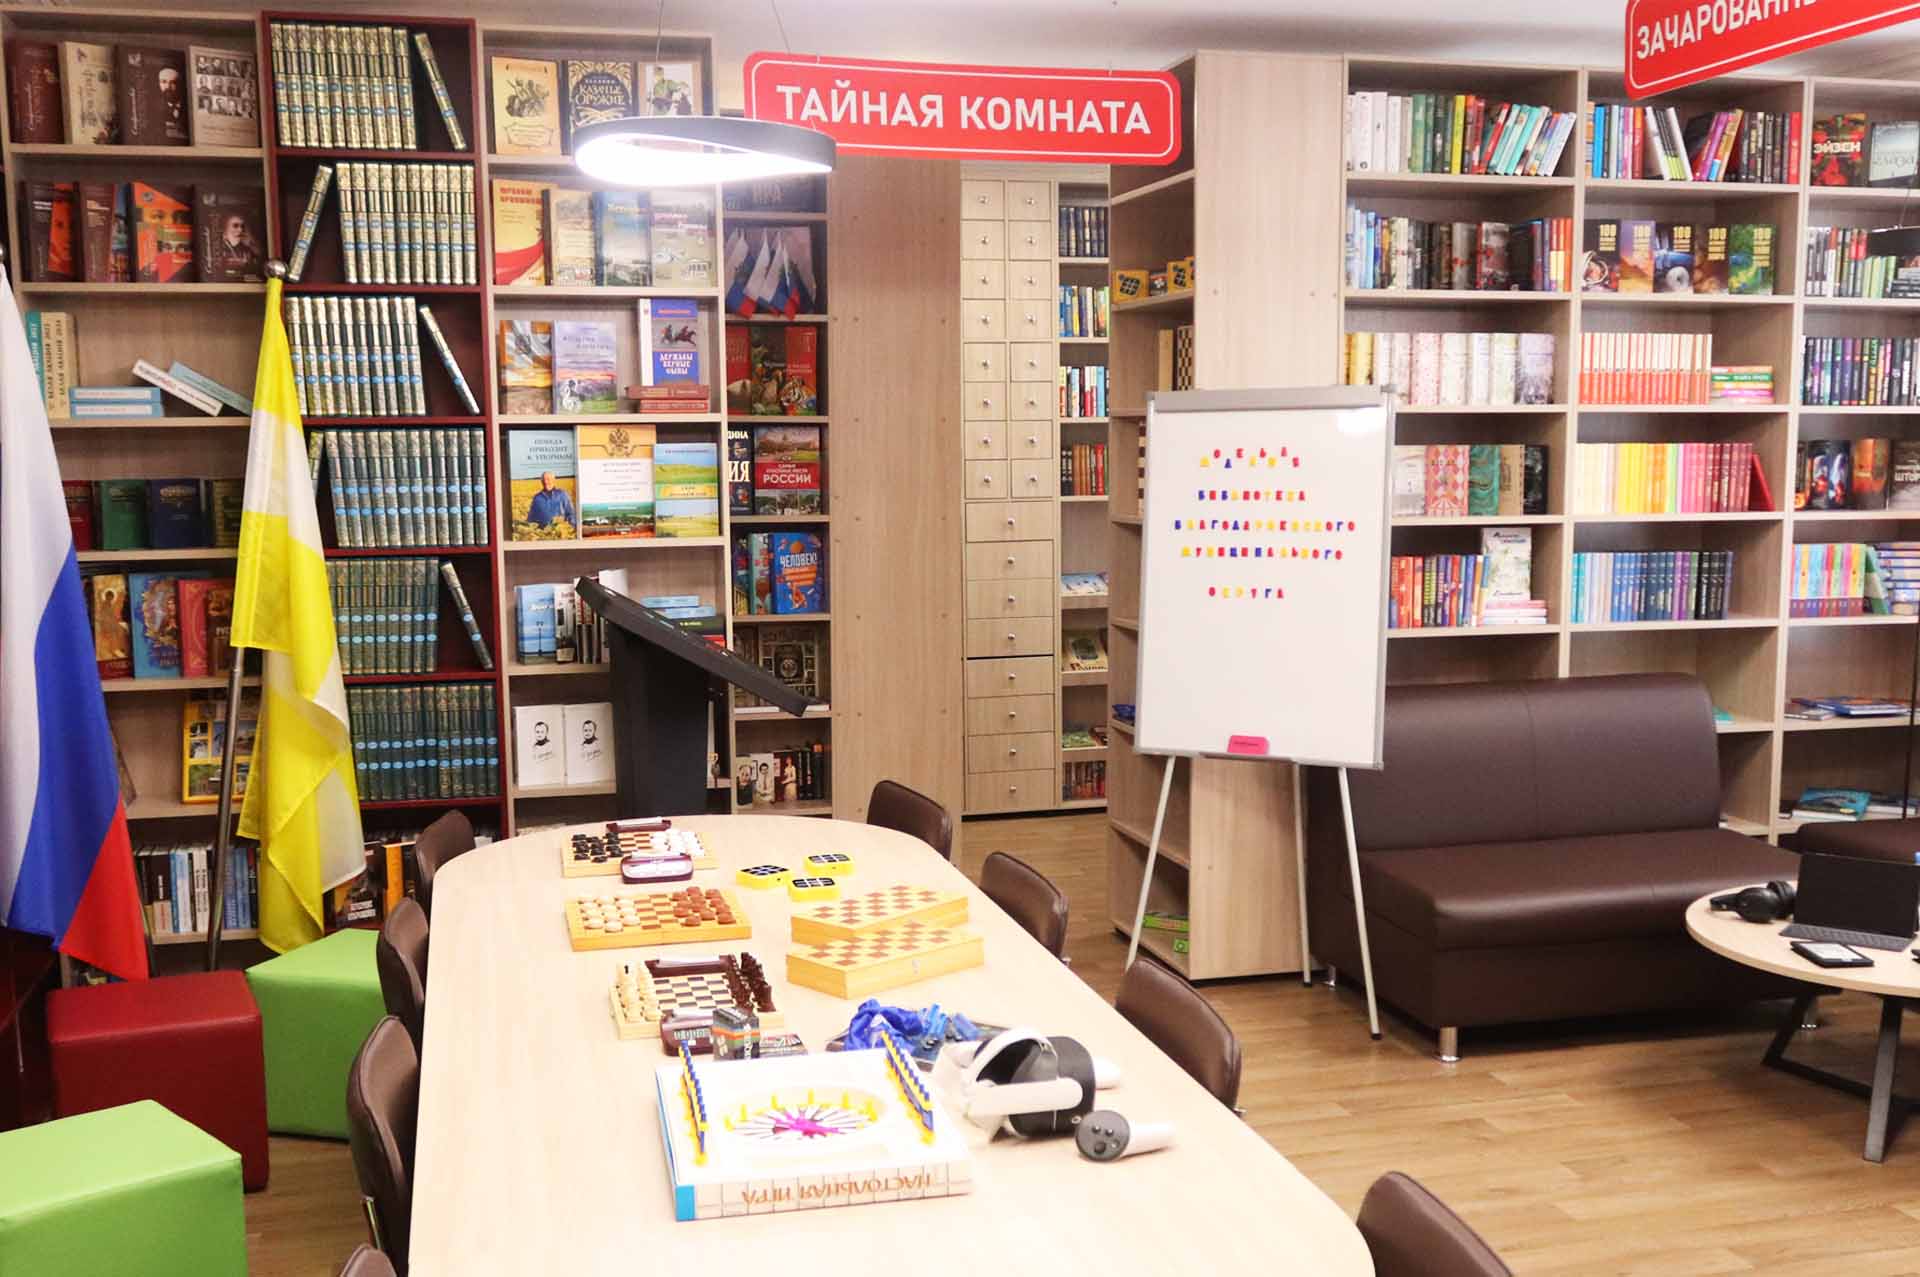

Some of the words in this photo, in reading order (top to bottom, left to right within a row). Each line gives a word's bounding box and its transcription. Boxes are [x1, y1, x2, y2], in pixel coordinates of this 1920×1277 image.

[1636, 0, 1817, 60] ЗАЧАРОВАН
[776, 79, 944, 129] ТАЙНАЯ
[960, 95, 1152, 135] КОМНАТА
[763, 473, 812, 484] РОССИИ
[1198, 490, 1306, 502] БИБЛИОТЕКА
[780, 551, 818, 568] ЧЕЛОВЕК!
[1180, 546, 1343, 560] МУНИЦИПАЛЬНОГО
[1208, 586, 1284, 599] ОКРУГА
[800, 1174, 932, 1200] НАСТОЛЬНАЯ
[741, 1186, 791, 1206] ИГРА
